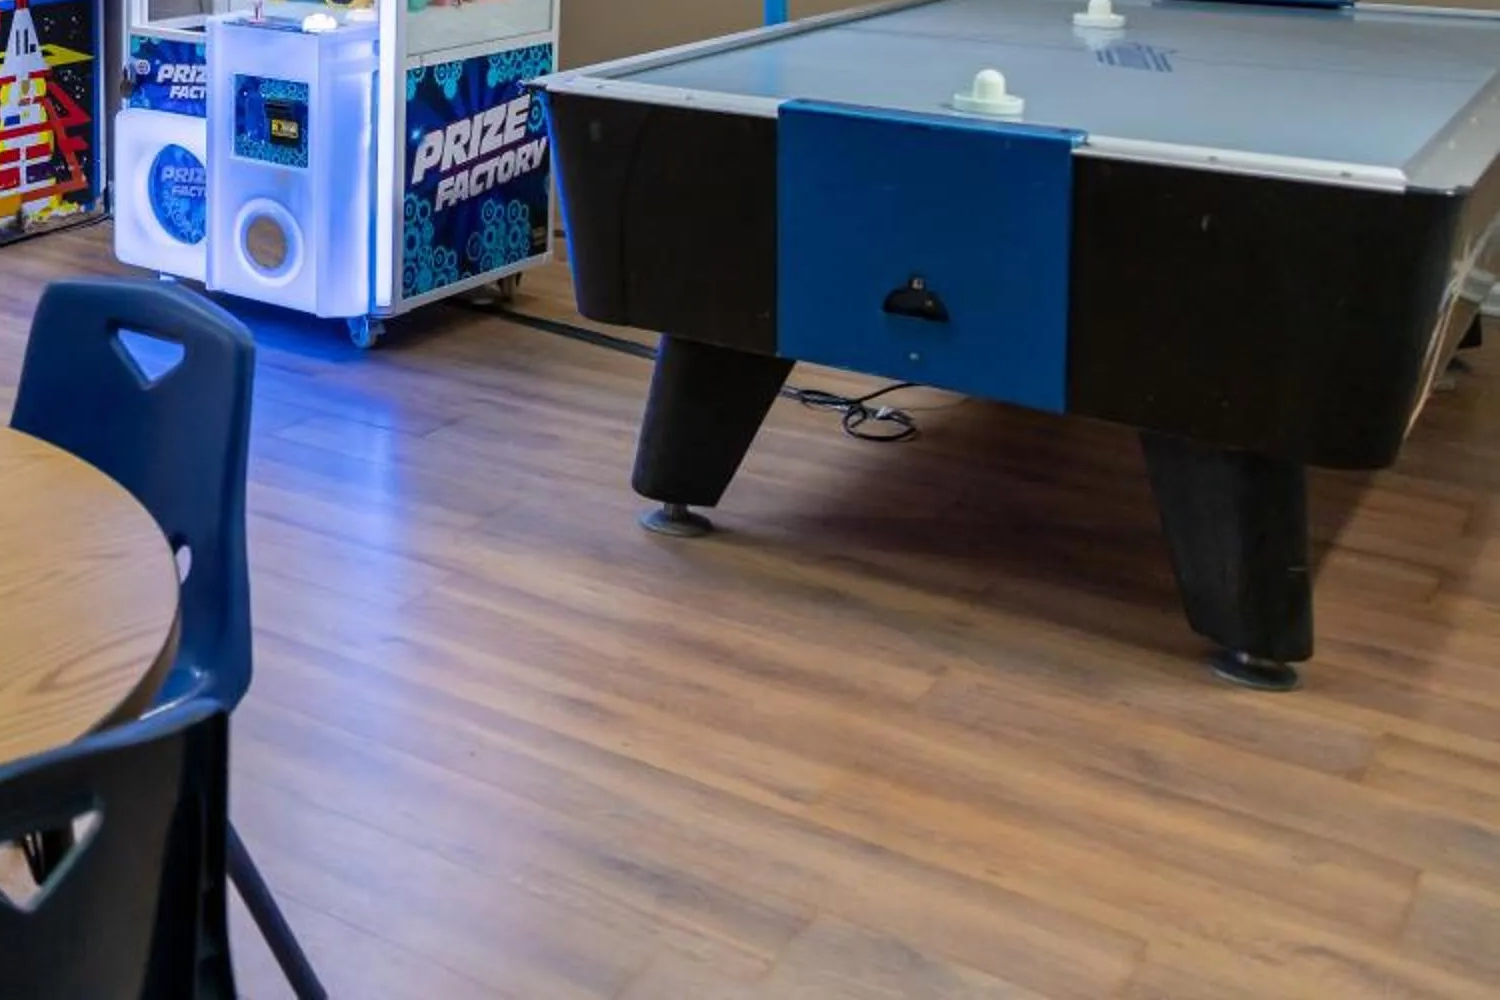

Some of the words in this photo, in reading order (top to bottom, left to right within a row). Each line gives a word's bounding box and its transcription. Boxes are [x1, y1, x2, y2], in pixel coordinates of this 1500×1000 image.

[156, 63, 207, 83] PRIZ
[169, 85, 207, 99] FACT
[412, 94, 531, 184] PRIZE
[161, 166, 206, 184] PRIZ
[435, 136, 550, 212] FACTORY
[171, 185, 206, 198] FACT
